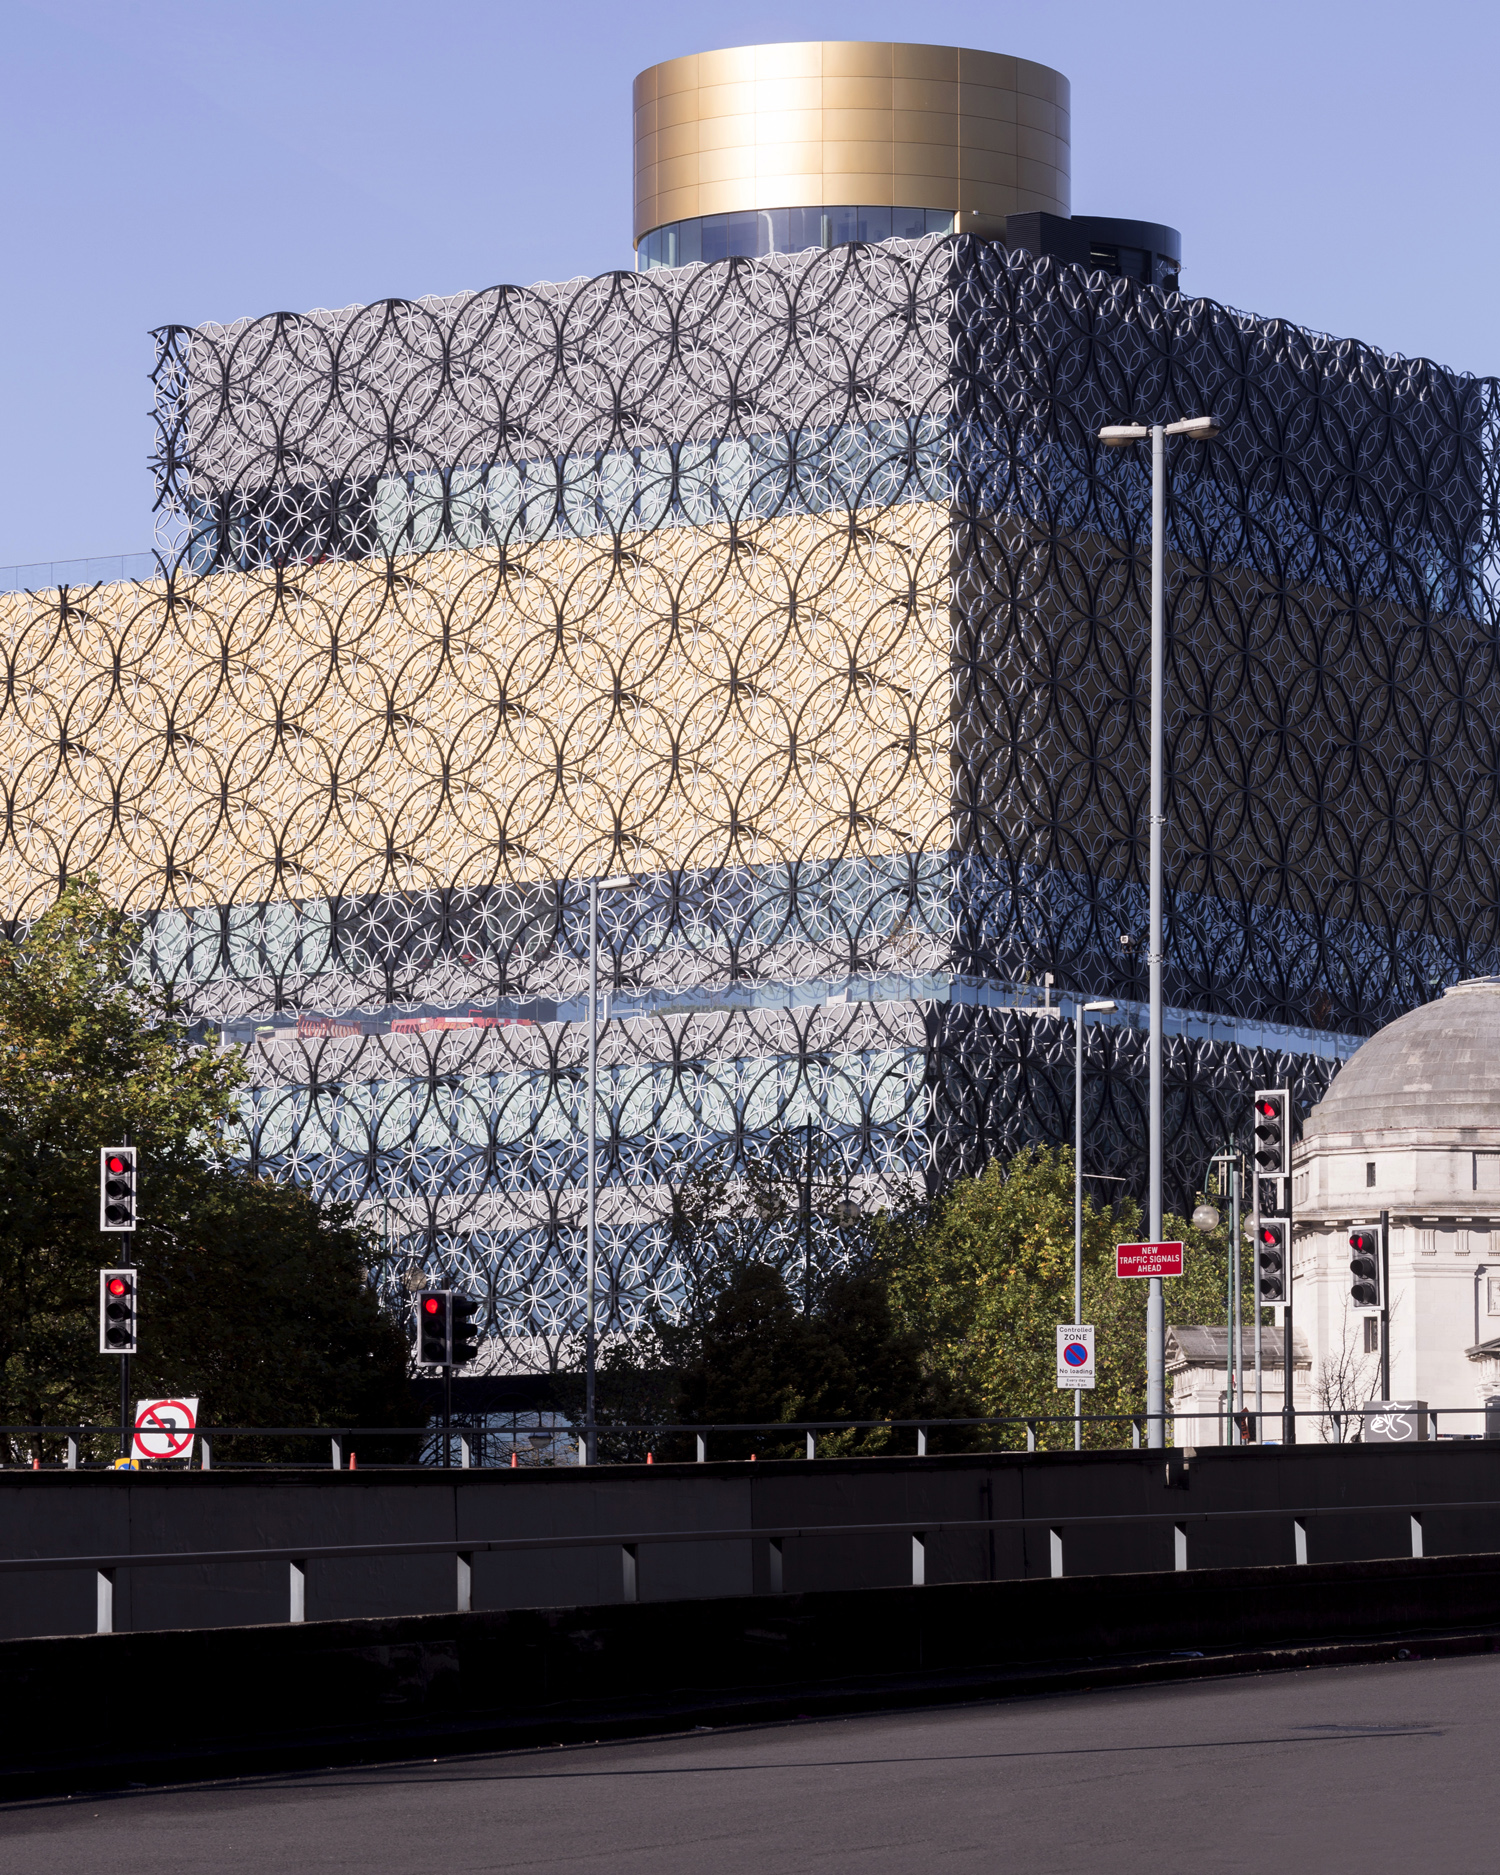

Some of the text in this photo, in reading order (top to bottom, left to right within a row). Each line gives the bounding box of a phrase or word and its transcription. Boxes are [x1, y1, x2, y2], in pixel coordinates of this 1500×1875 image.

[1141, 1246, 1158, 1255] NEW
[1119, 1254, 1180, 1264] TRAFFIC SIGNALS
[1137, 1264, 1162, 1273] AHEAD
[1064, 1333, 1088, 1341] ZONE
